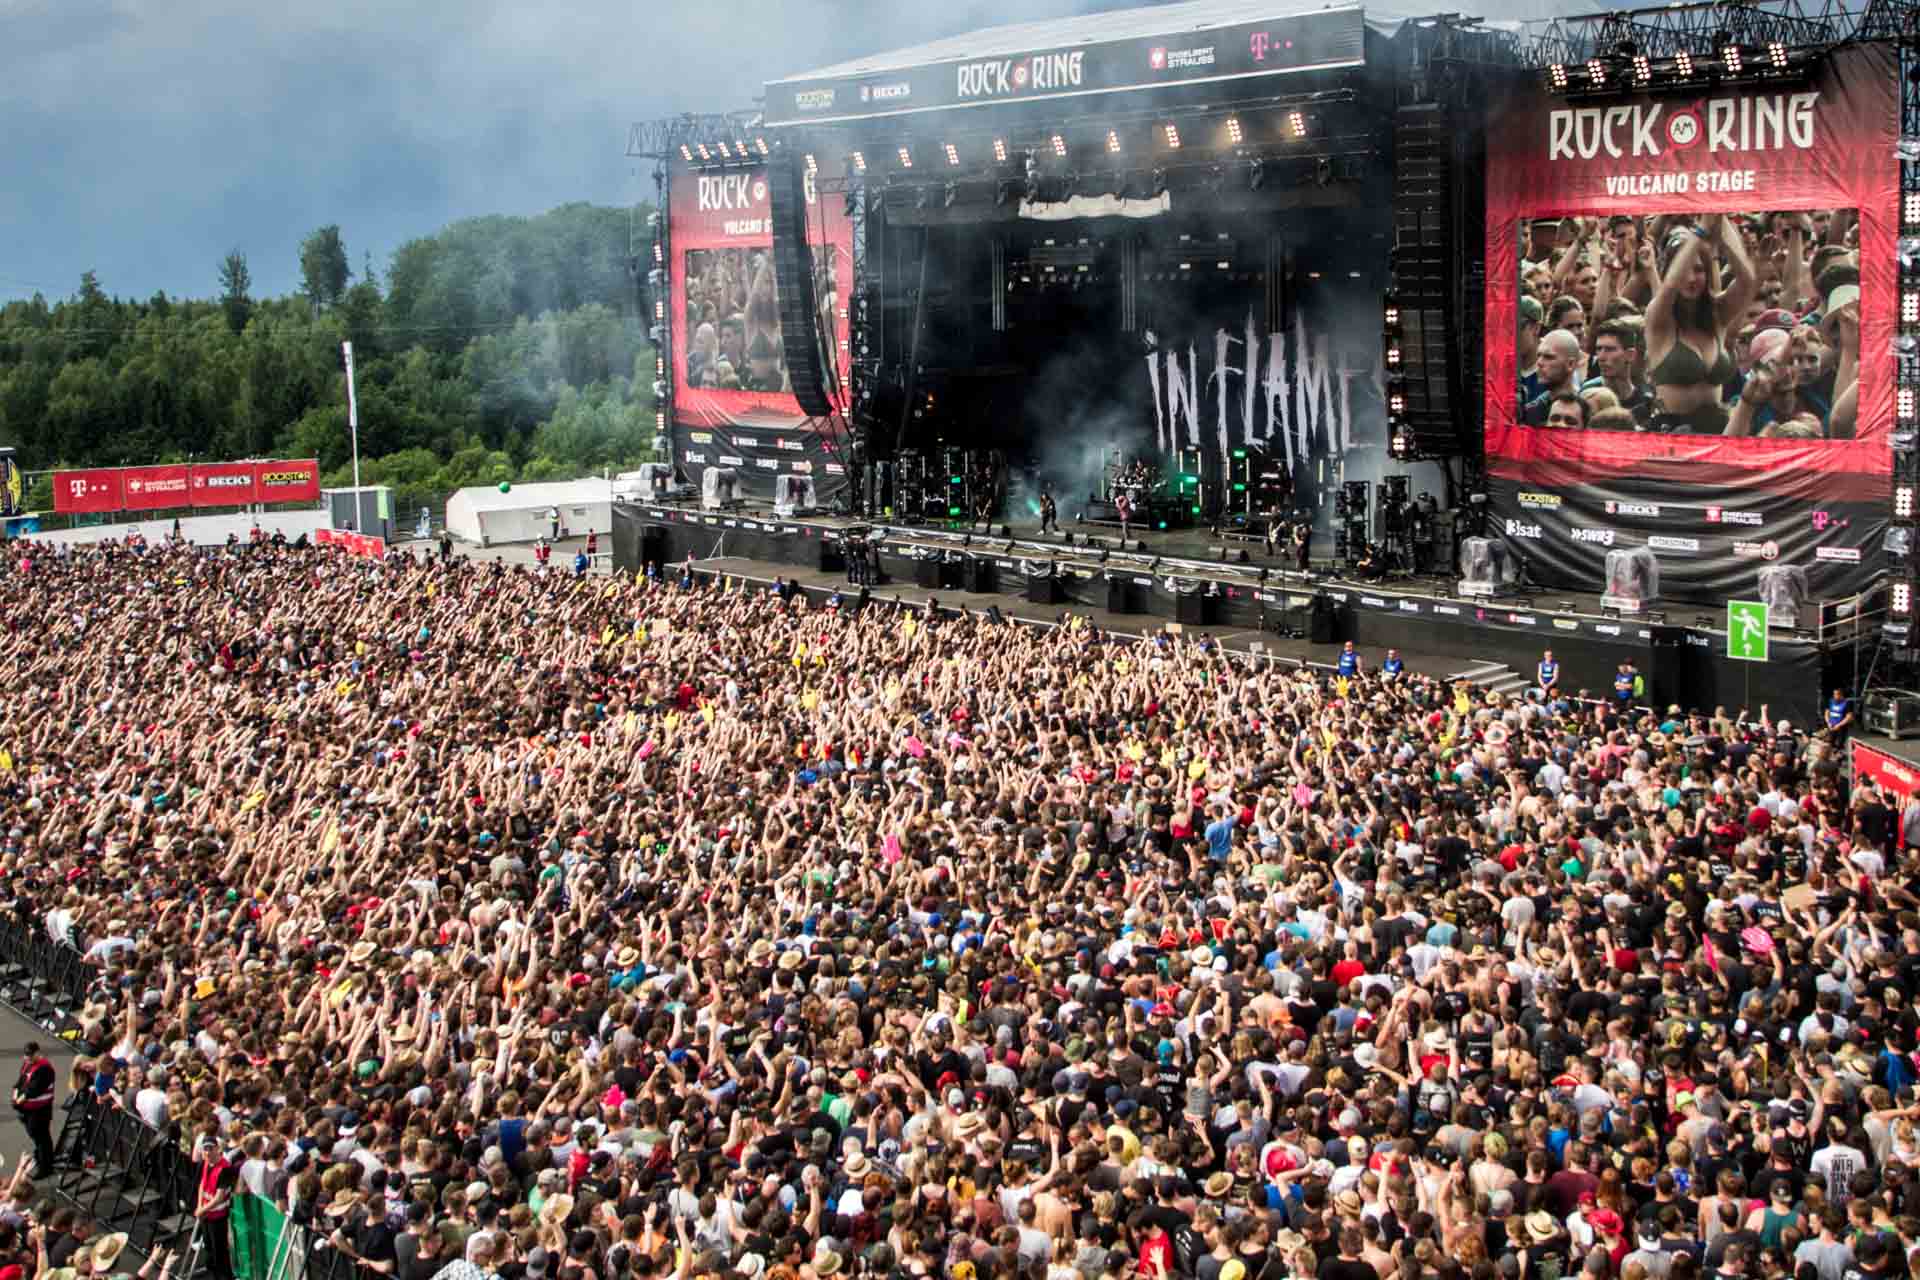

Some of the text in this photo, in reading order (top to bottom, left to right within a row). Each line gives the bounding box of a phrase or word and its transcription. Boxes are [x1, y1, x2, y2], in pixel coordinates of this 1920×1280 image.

[958, 51, 1085, 96] ROCK RING
[1549, 102, 1663, 160] ROCK
[1708, 91, 1819, 152] RING
[698, 174, 750, 211] ROCK
[1606, 170, 1755, 196] VOLCANO STAGE
[262, 471, 312, 481] ROCKSTAR
[1830, 1158, 1854, 1172] WIR
